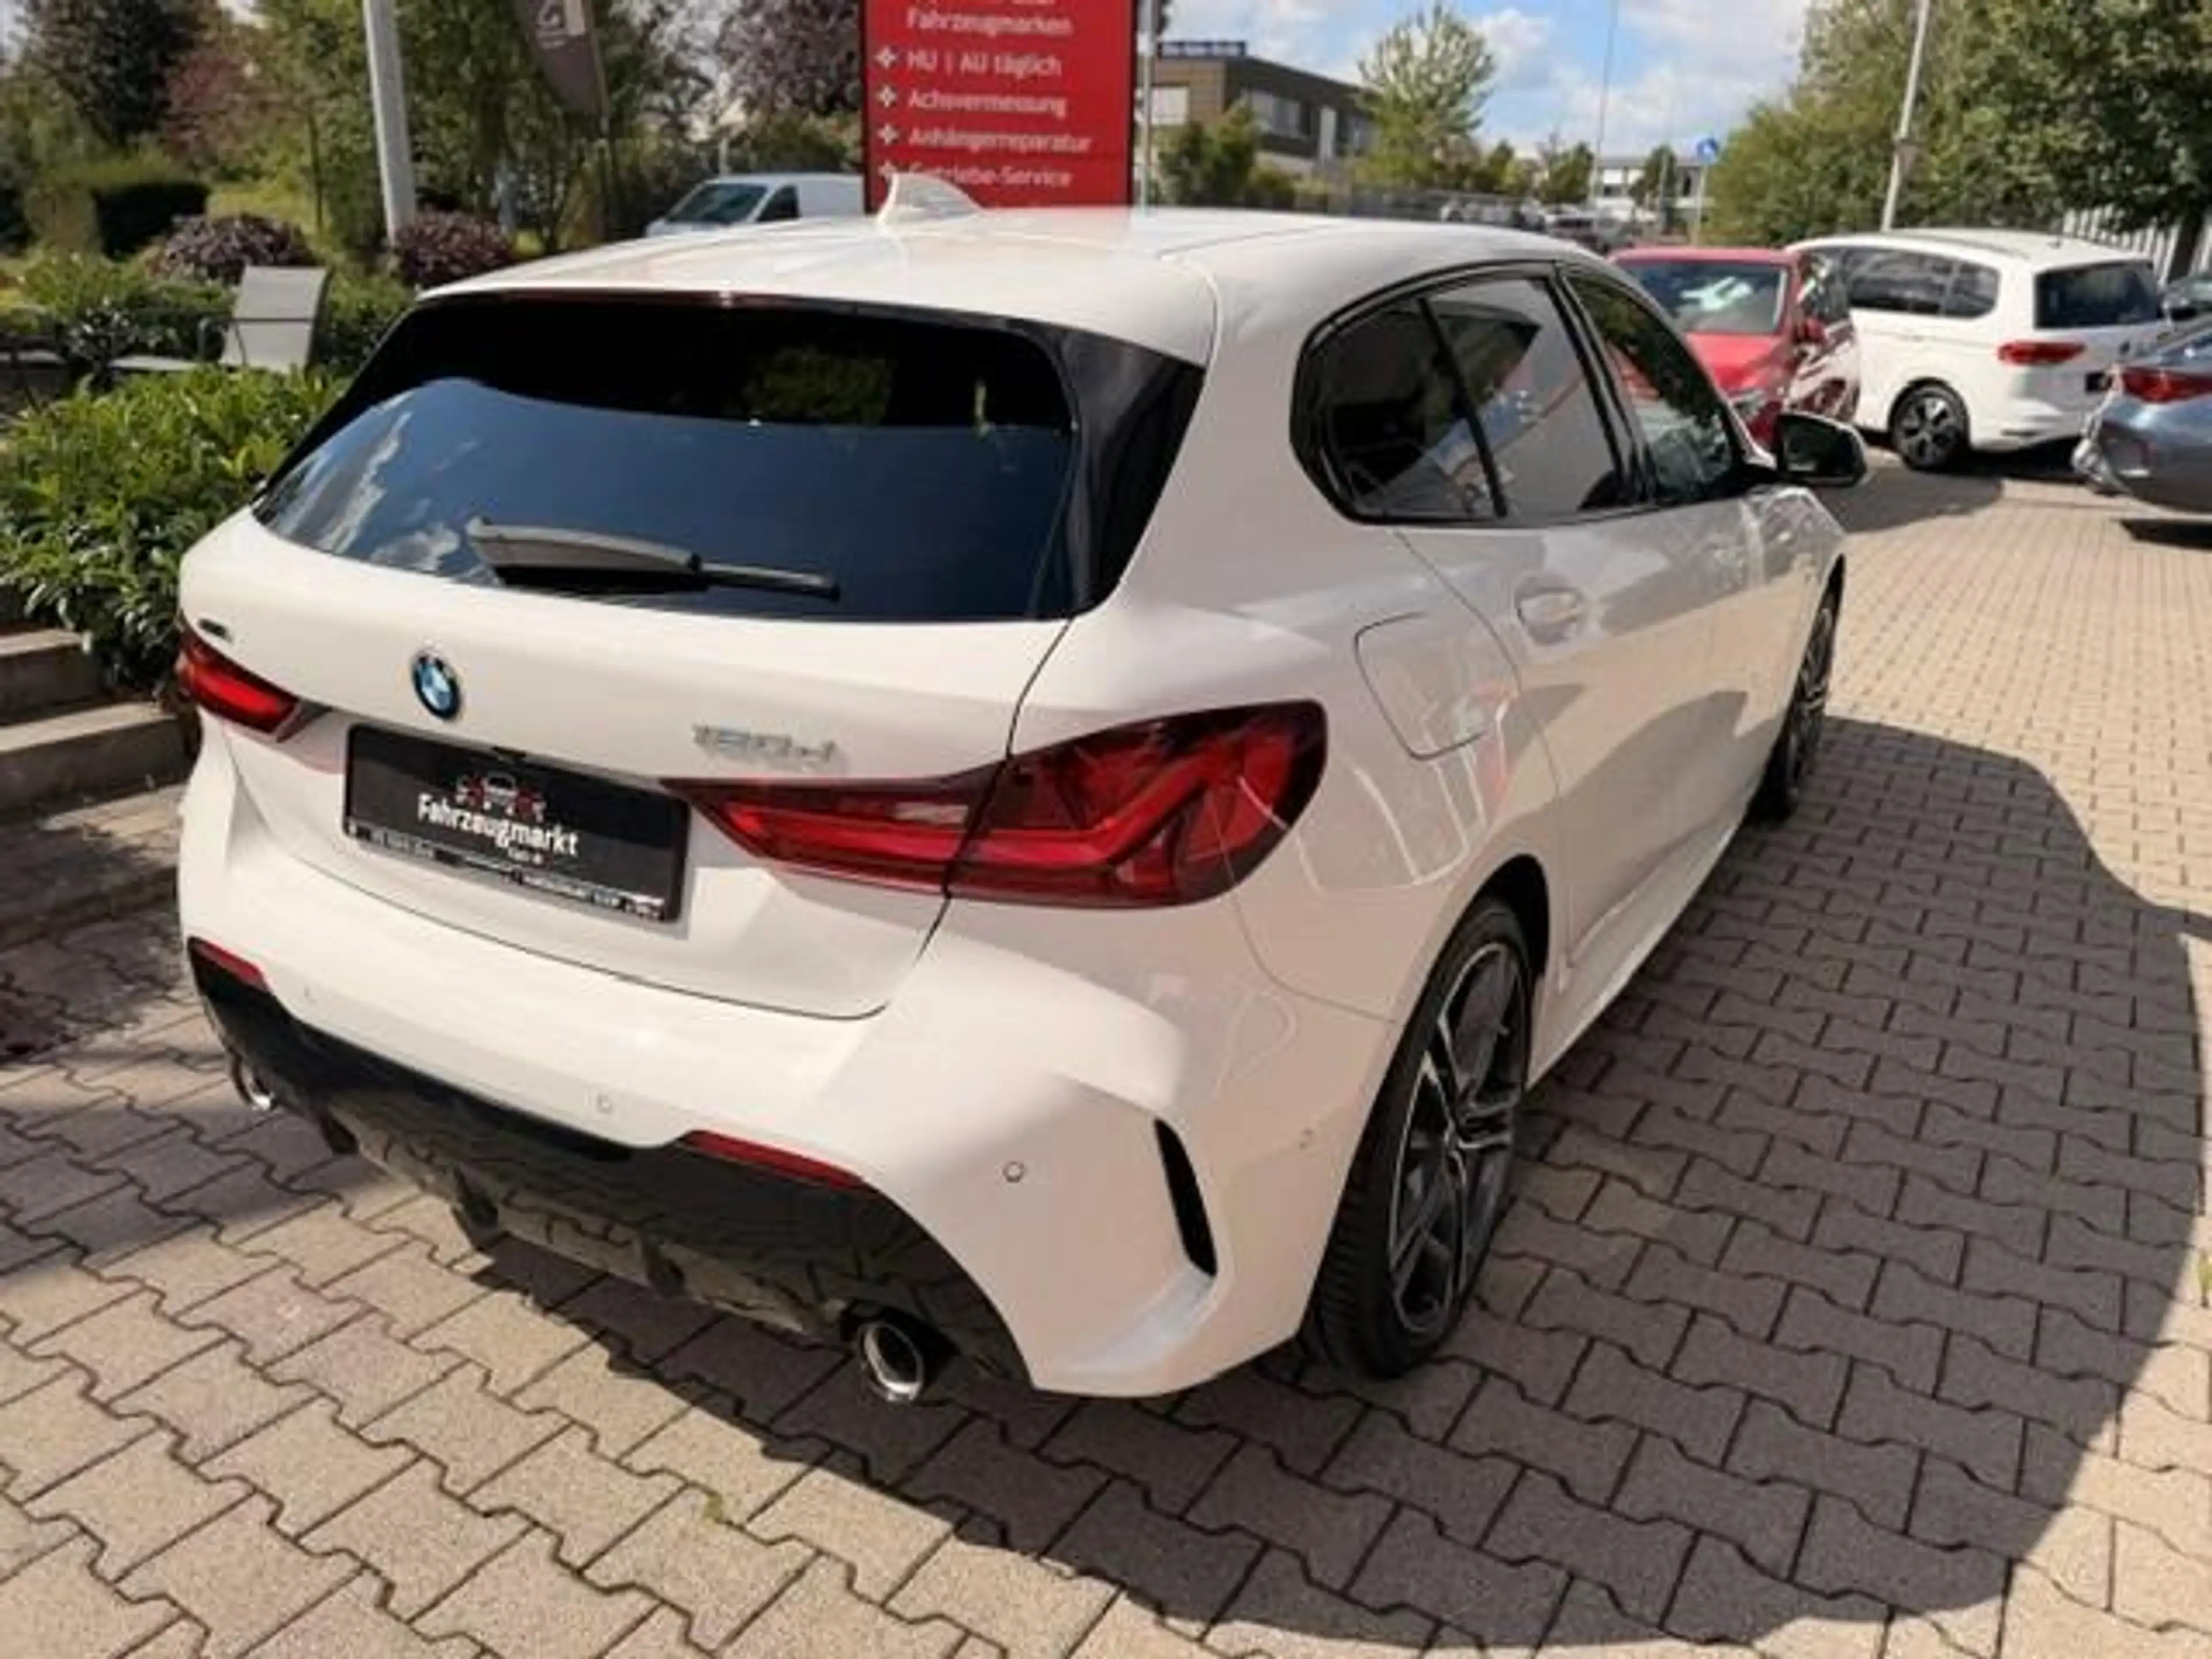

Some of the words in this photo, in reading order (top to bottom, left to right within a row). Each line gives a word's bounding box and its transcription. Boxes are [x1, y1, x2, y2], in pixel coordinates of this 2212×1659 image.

[907, 6, 1074, 37] Fahrzeugmarken
[907, 50, 937, 73] HU
[960, 51, 987, 74] AU
